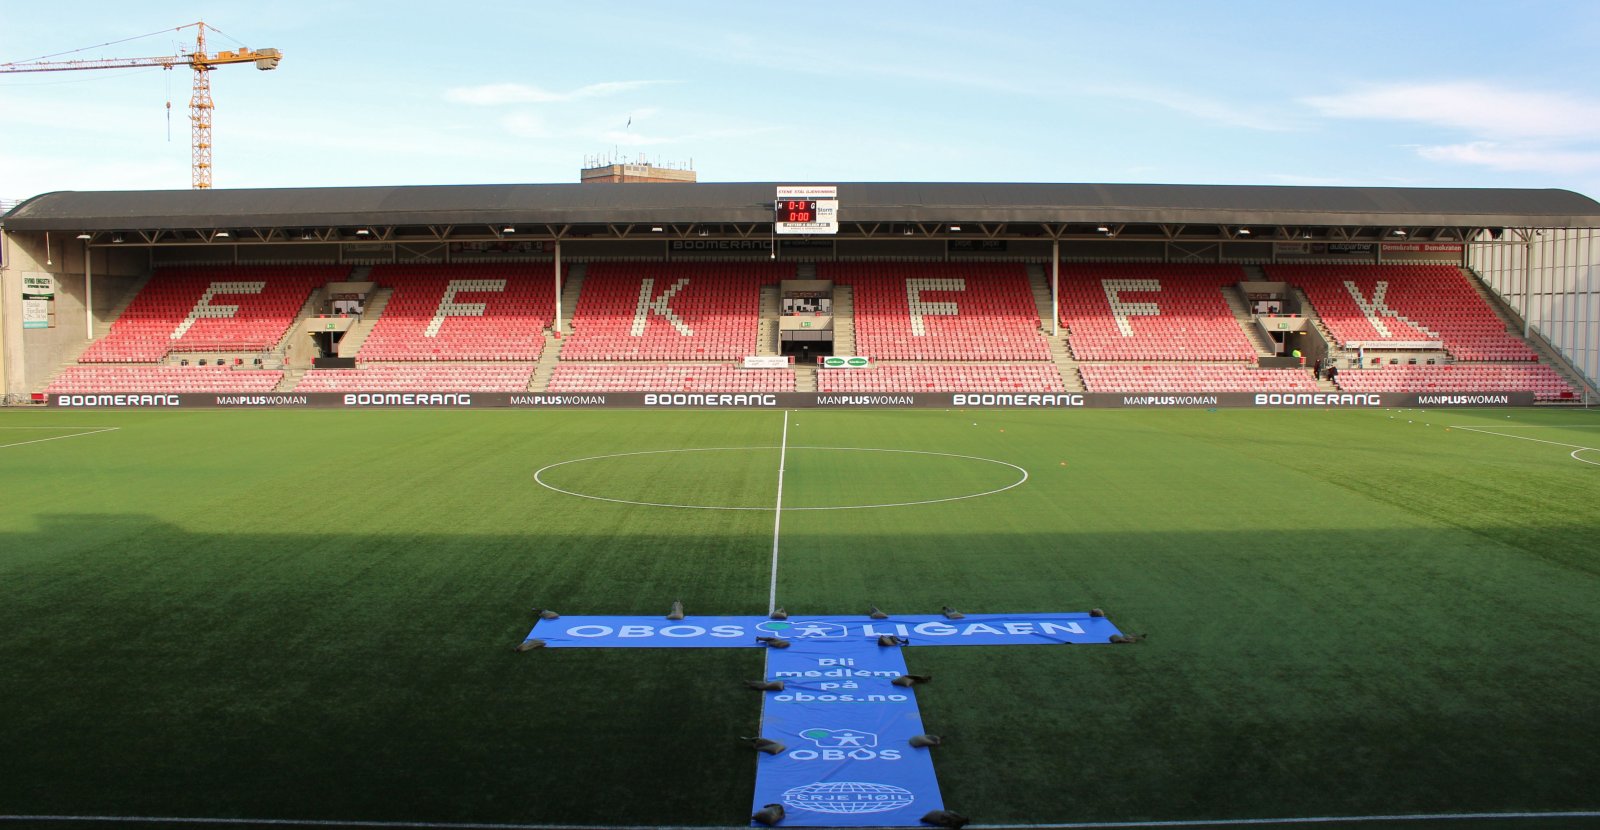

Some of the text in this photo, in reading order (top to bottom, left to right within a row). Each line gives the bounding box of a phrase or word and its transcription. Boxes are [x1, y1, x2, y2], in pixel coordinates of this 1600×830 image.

[630, 278, 693, 337] K
[905, 278, 966, 337] F
[58, 393, 1509, 407] BOOMERANG MANPLUSWOMAN BOOMERANG MANPLUSWOMAN BOOMERANG MANPLUSWOMAN BOOMERANG MANPLUSWOMAN BOOMERANG MANPLUSWOMAN
[565, 621, 1085, 639] OBOS LIGAEN
[818, 657, 854, 667] Bli
[775, 668, 901, 678] medlem
[820, 680, 859, 691] på
[773, 692, 908, 703] obos.no
[788, 748, 902, 761] OBOS
[782, 793, 850, 802] TERJE
